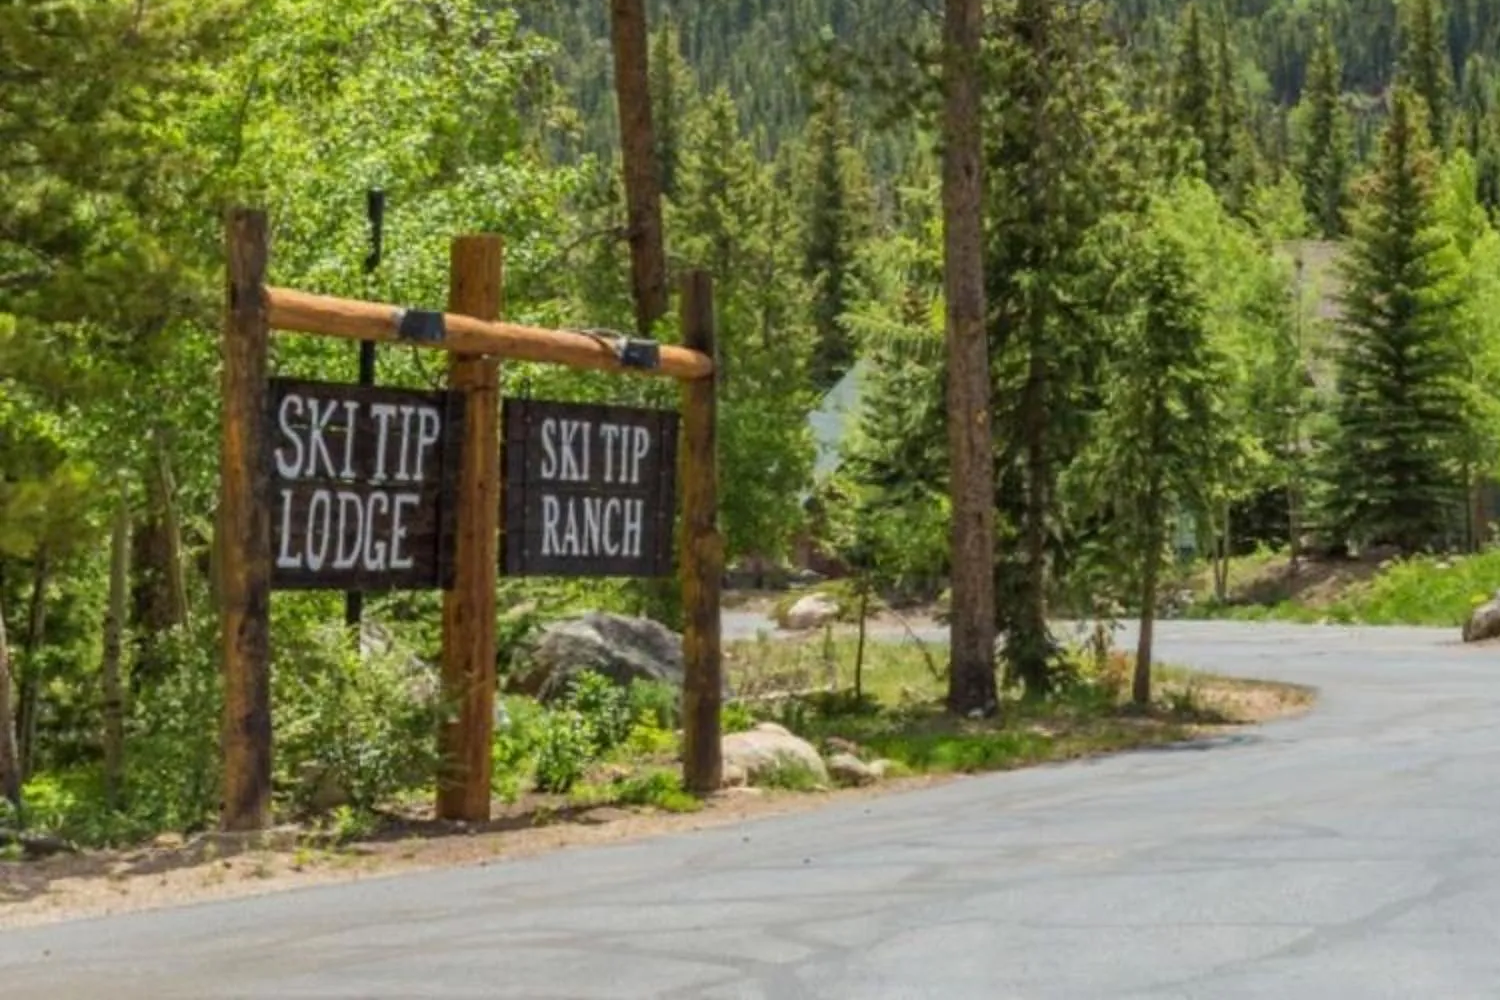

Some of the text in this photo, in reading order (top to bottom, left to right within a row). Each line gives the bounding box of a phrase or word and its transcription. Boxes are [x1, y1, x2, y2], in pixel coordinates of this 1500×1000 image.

[274, 394, 440, 484] SKI TIP
[540, 418, 650, 485] SKI TIP
[276, 489, 420, 571] LODGE
[540, 495, 643, 558] RANCH
